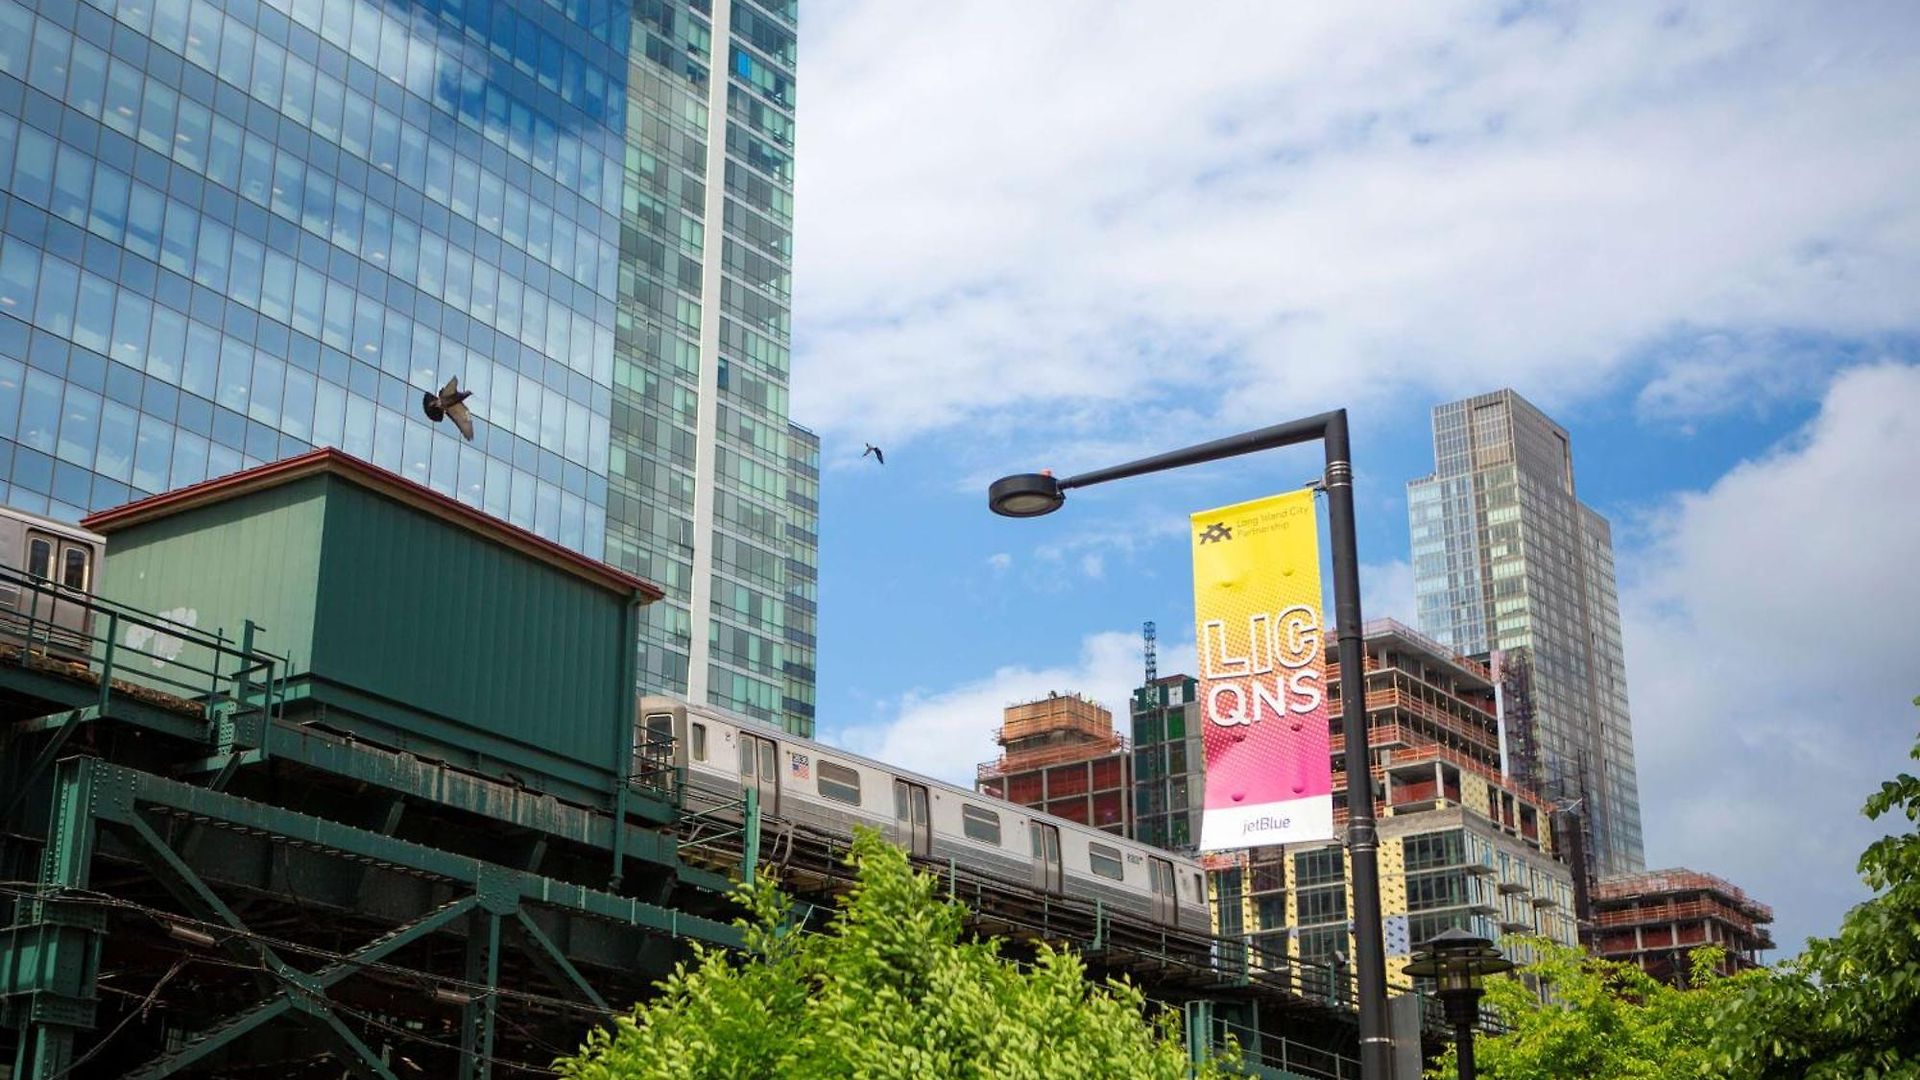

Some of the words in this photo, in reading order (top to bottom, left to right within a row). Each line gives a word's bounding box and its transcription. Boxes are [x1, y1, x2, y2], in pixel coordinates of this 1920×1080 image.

[1237, 517, 1259, 528] Long
[1260, 509, 1288, 521] Island
[1290, 506, 1310, 517] City
[1237, 522, 1290, 537] Partnership
[1208, 670, 1321, 727] QNS
[1242, 816, 1292, 837] jetBlue
